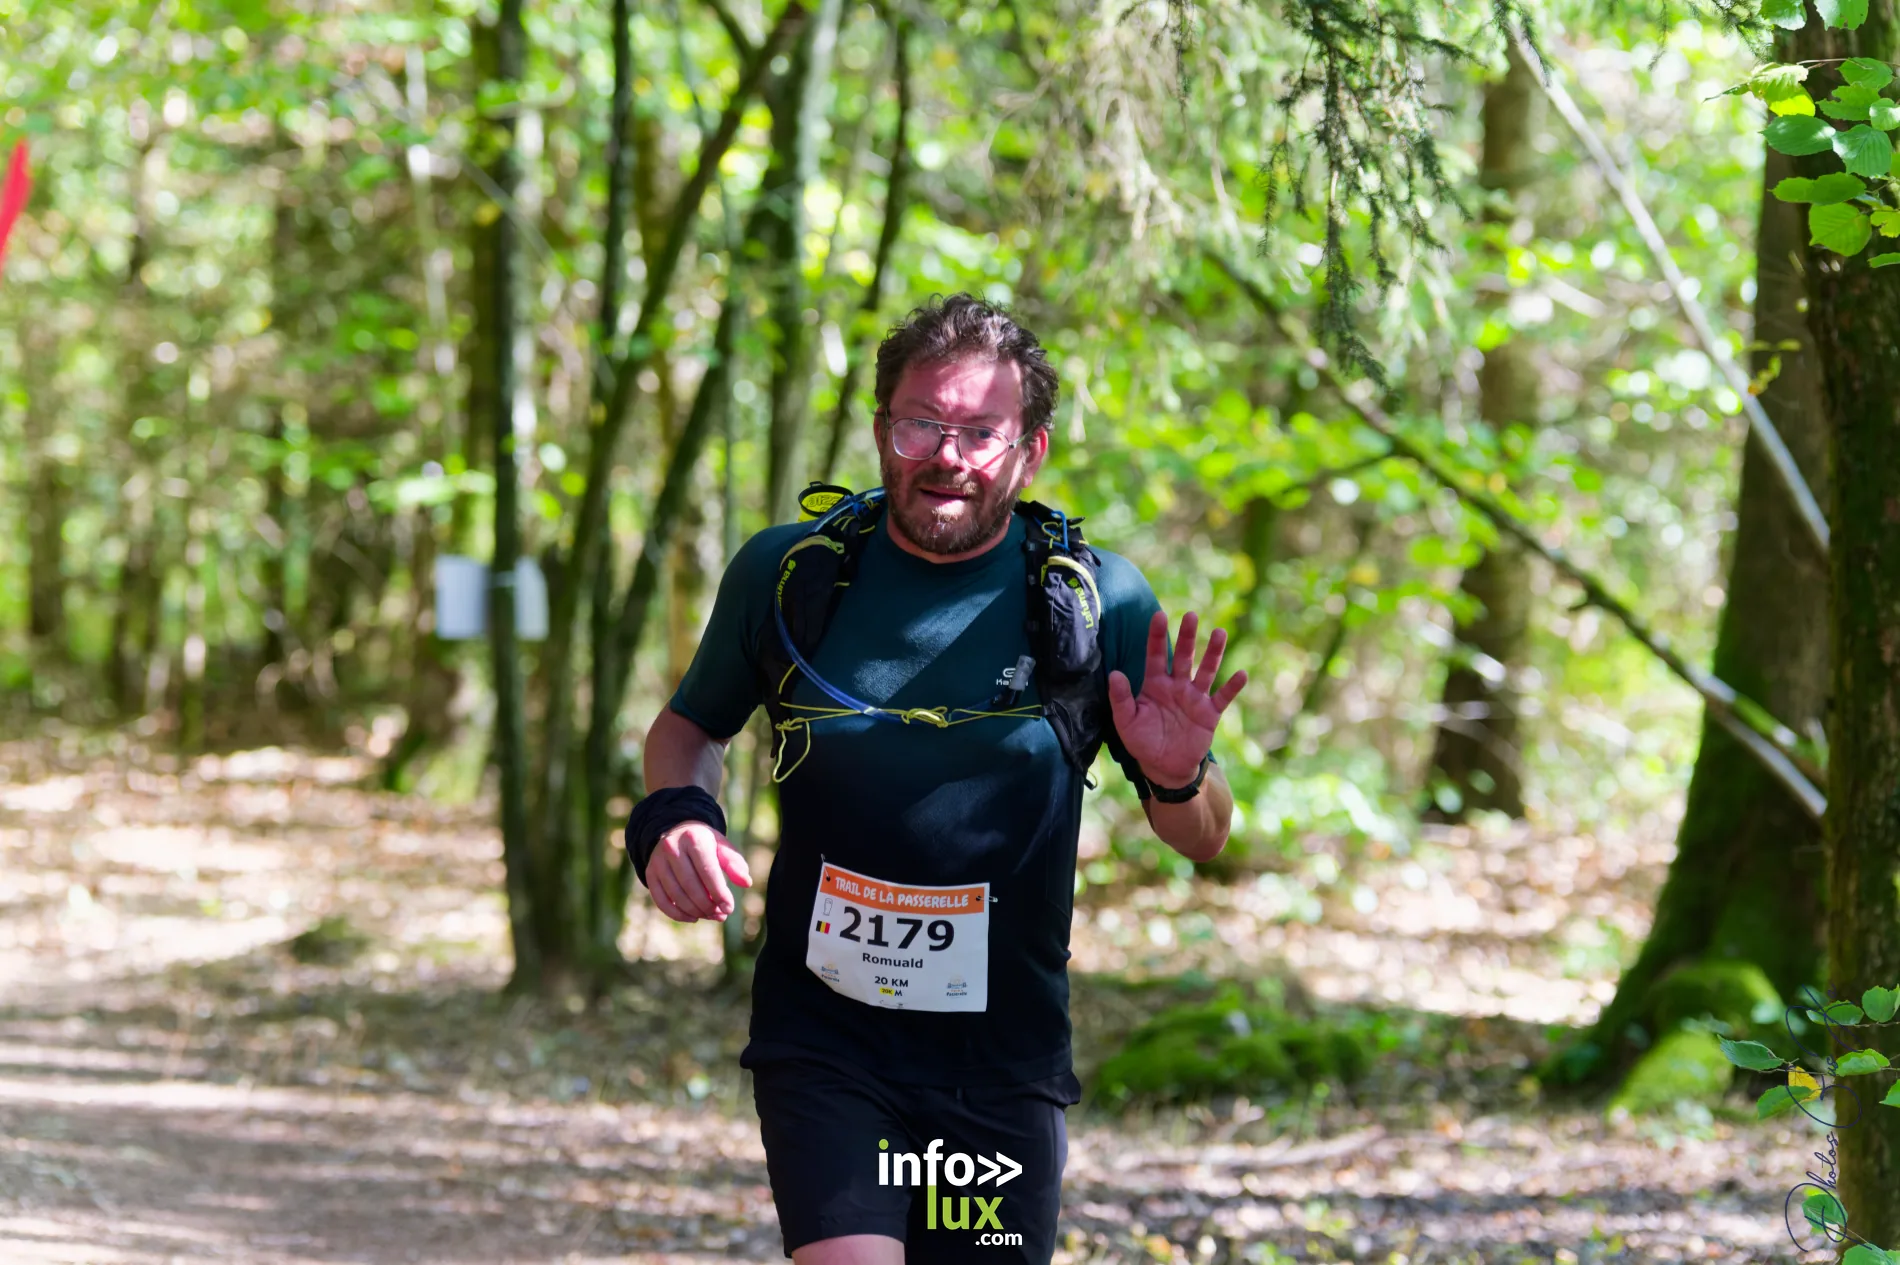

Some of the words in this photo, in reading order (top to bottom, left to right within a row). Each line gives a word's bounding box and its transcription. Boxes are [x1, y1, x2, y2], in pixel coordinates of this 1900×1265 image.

[1075, 587, 1094, 629] Lafuma
[835, 876, 862, 897] TRAIL
[863, 886, 877, 899] DE
[879, 890, 895, 905] LA
[897, 893, 969, 909] PASSERELLE
[839, 906, 955, 951] 2179
[862, 952, 924, 969] Romuald
[874, 976, 889, 986] 20
[891, 978, 909, 988] KM
